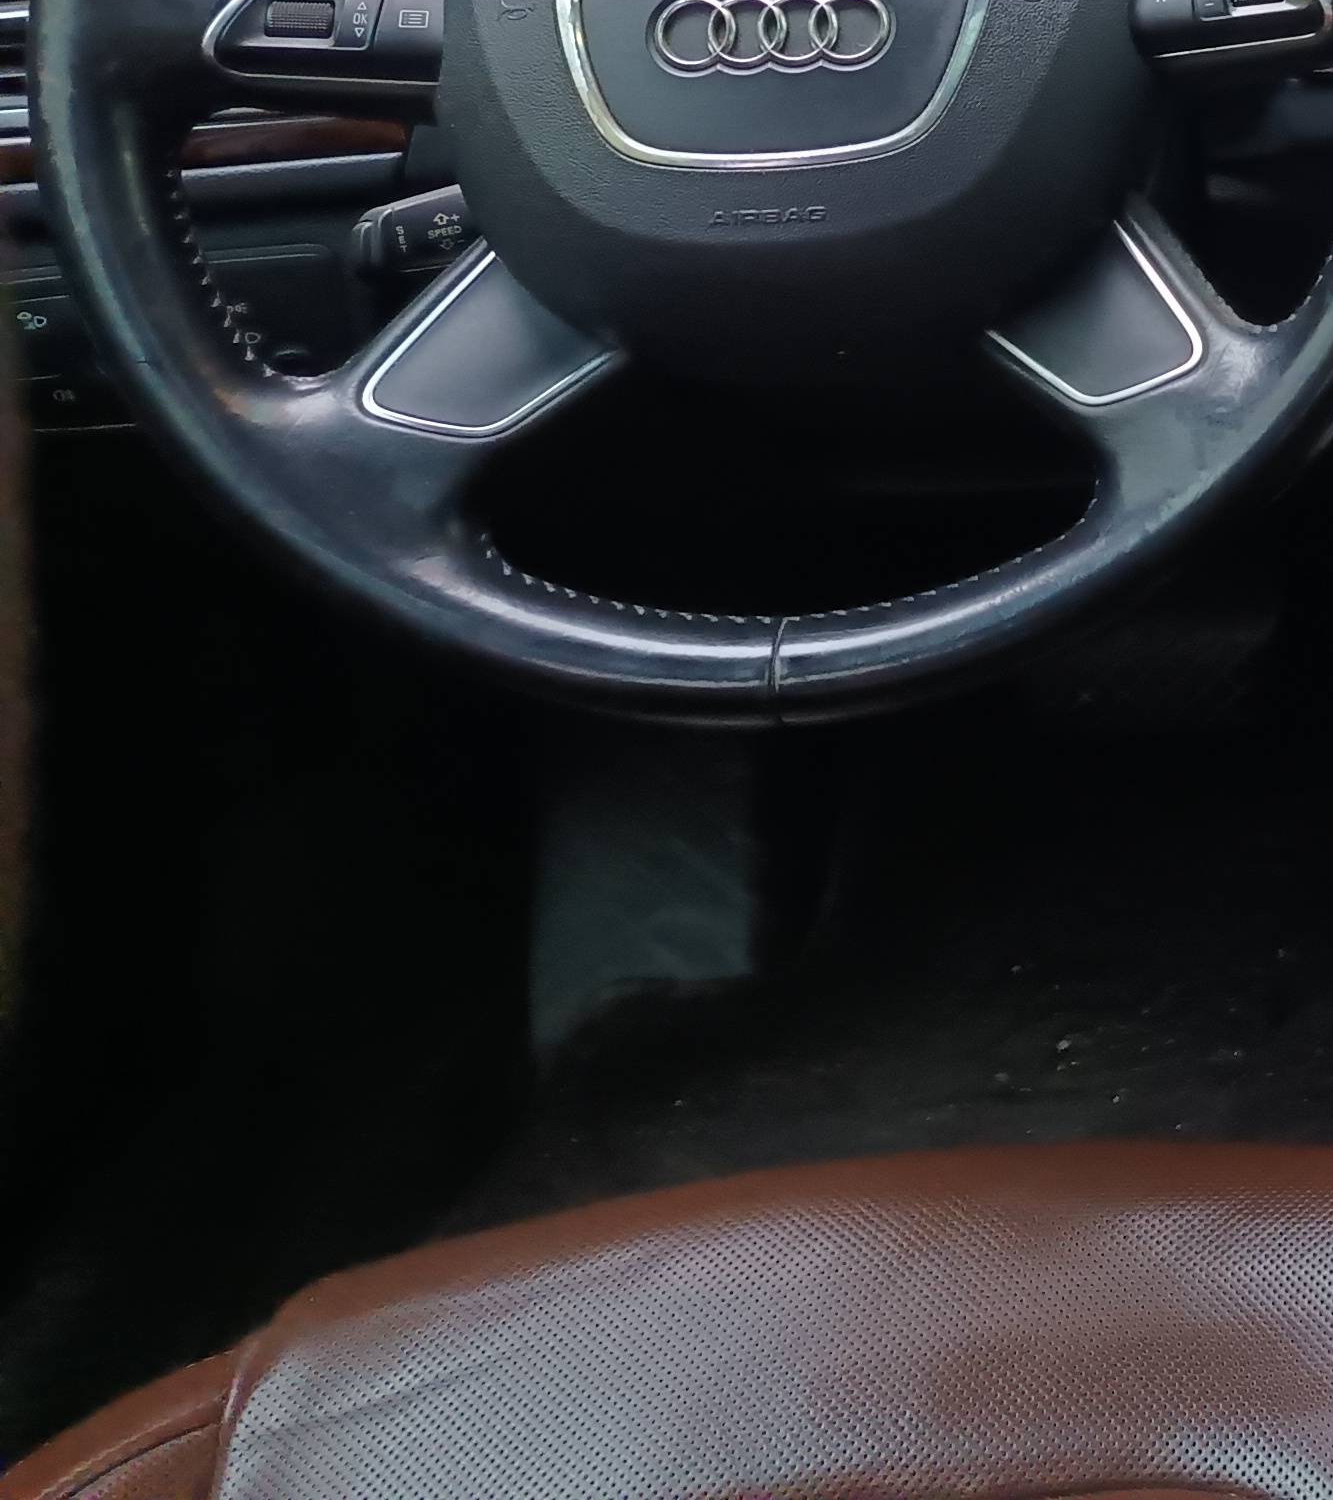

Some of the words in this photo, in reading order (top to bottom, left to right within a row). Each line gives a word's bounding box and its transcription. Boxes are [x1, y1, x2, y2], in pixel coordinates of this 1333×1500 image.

[352, 12, 367, 26] OK
[395, 225, 408, 253] SET
[427, 225, 462, 240] SPEED
